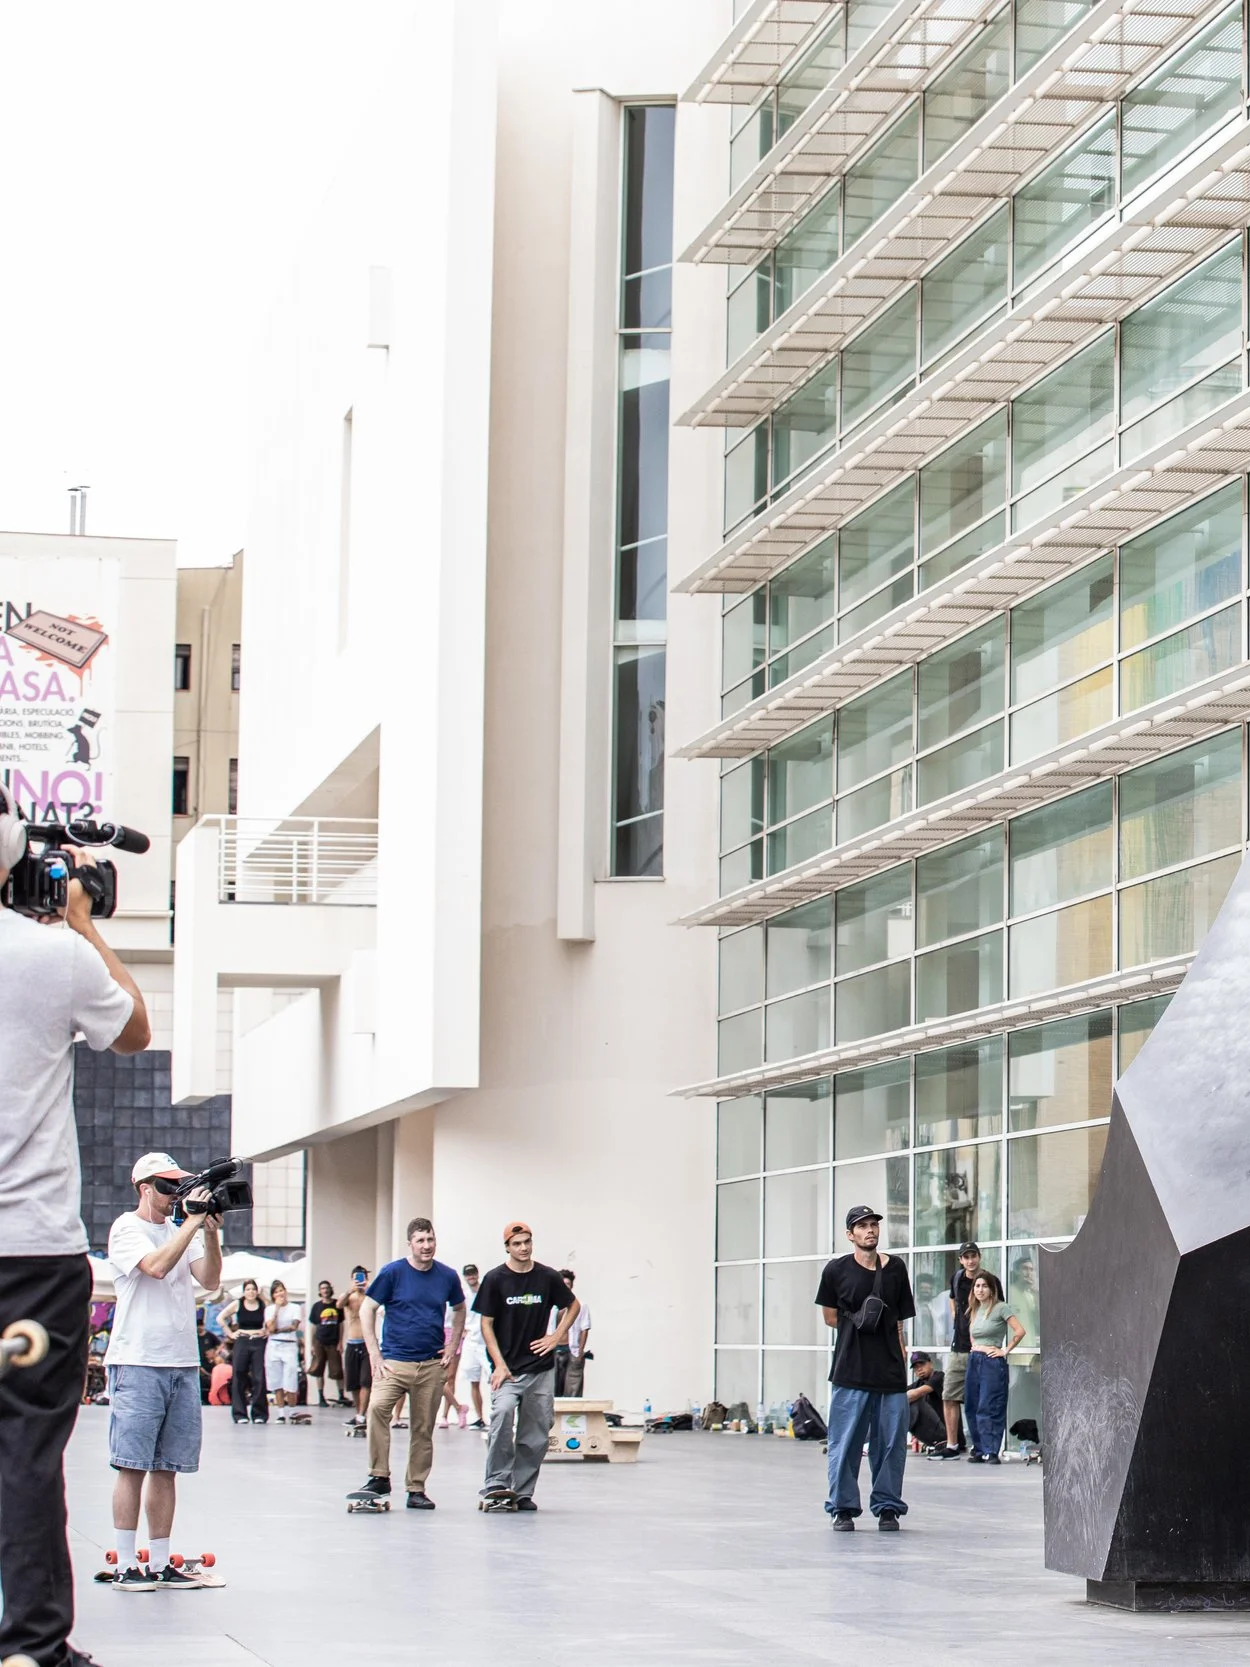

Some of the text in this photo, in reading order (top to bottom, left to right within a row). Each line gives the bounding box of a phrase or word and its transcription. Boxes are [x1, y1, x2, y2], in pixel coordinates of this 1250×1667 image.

[23, 622, 88, 654] WELCOME
[49, 622, 77, 637] NOT
[13, 768, 103, 815] NO!
